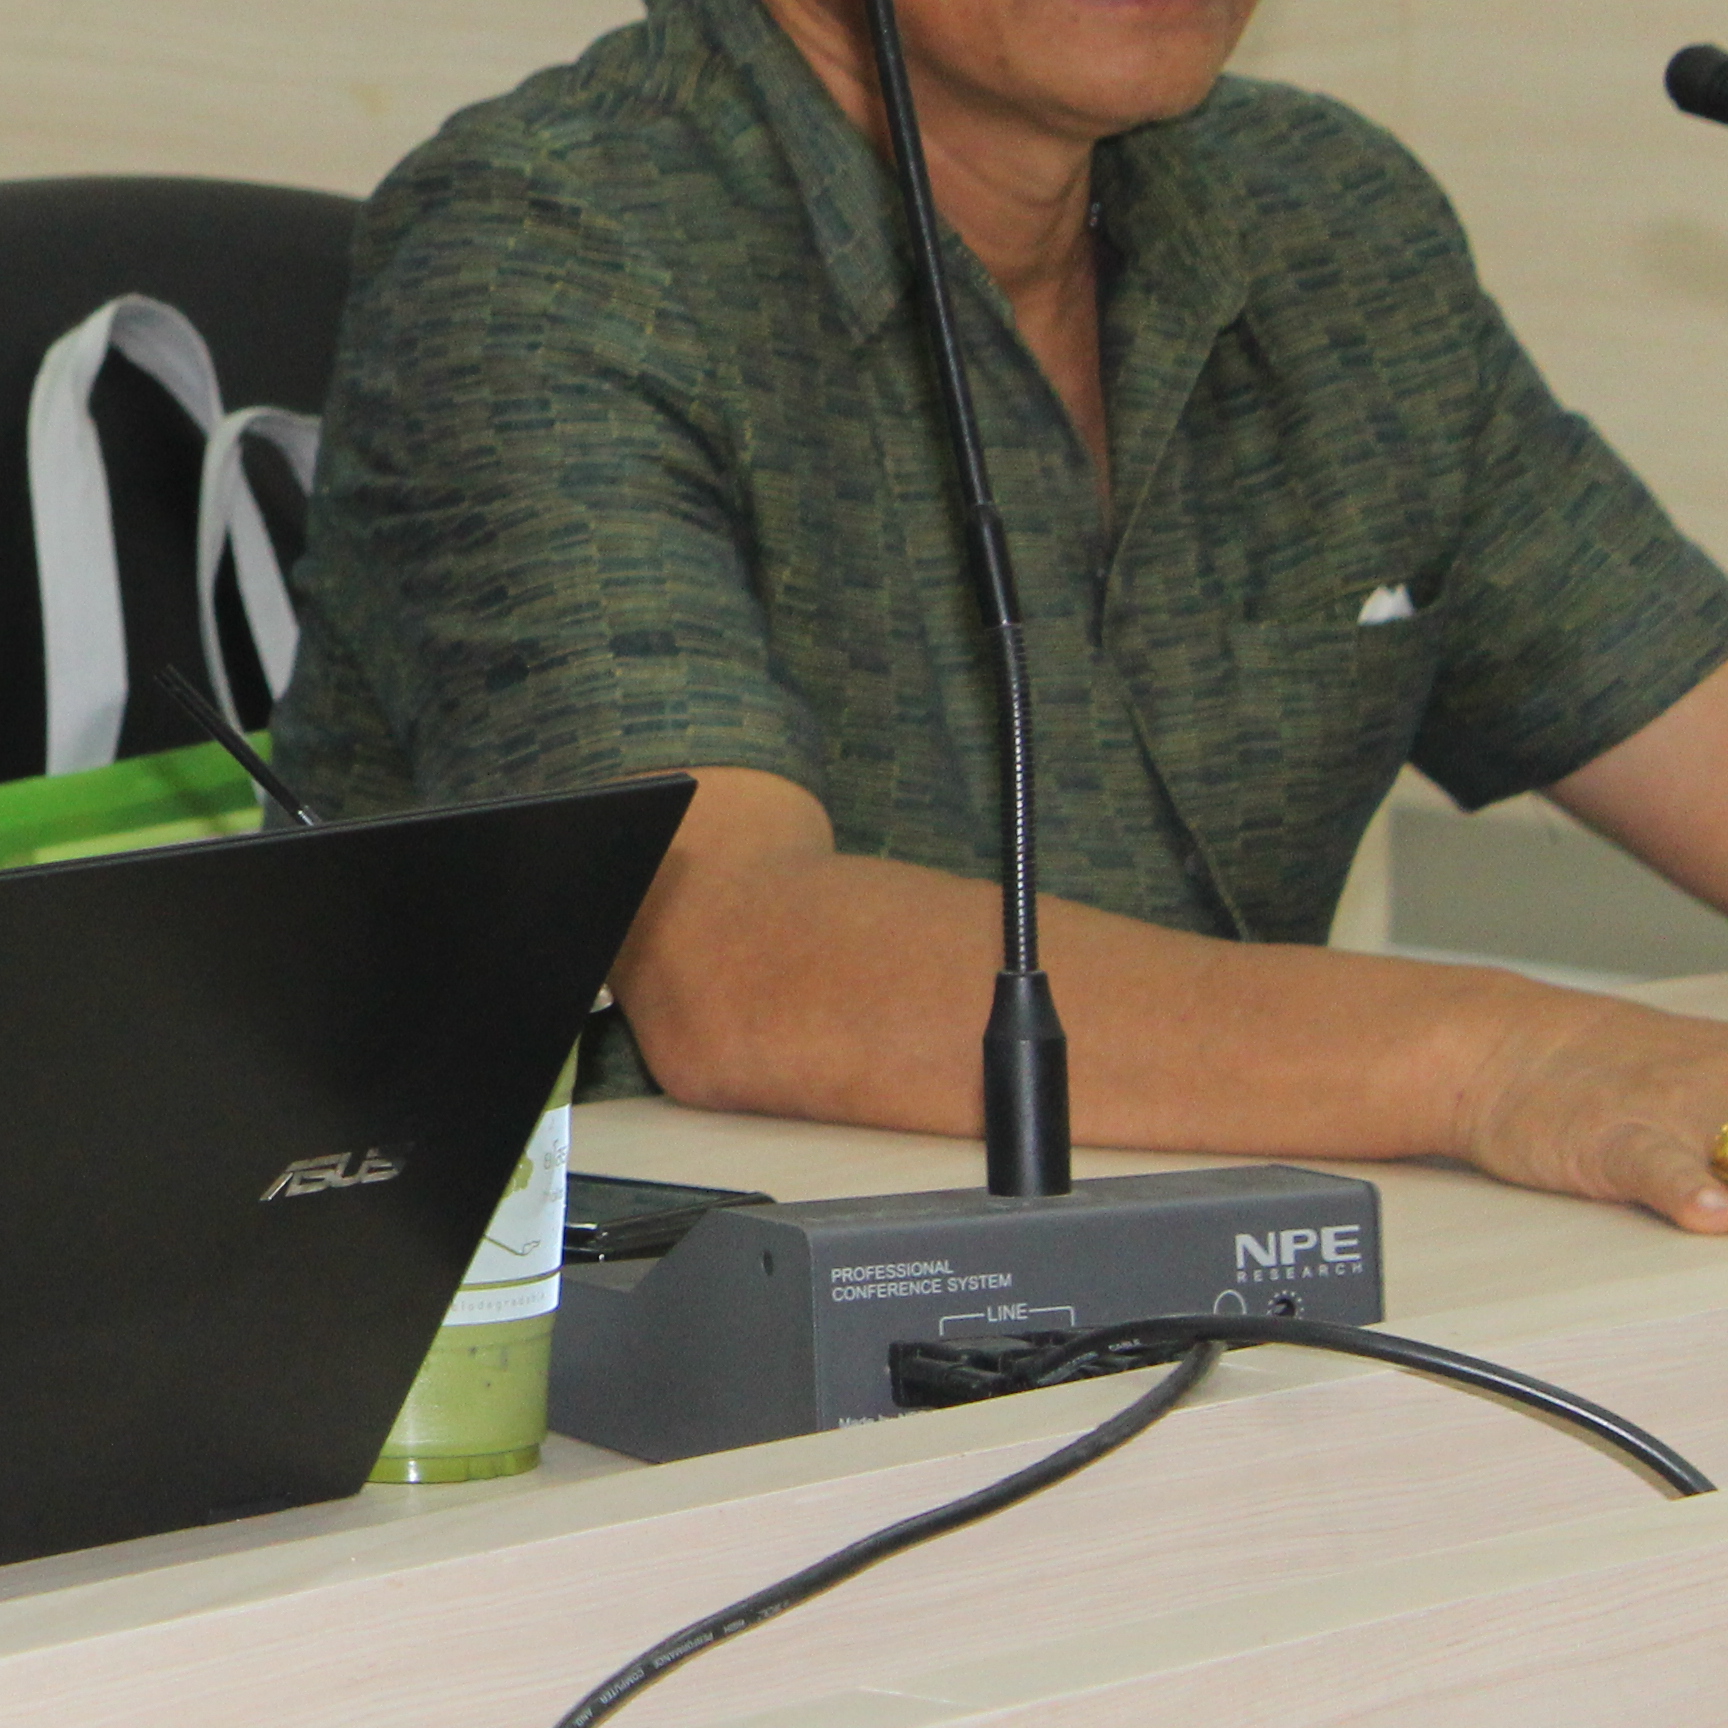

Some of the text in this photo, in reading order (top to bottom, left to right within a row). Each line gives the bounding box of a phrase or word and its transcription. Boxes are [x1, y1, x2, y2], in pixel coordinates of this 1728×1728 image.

[258, 1141, 414, 1202] ASUS
[1235, 1224, 1362, 1270] NPE
[830, 1260, 954, 1284] PROFESSIONAL
[1236, 1262, 1364, 1283] RESEARCH
[831, 1273, 1013, 1302] CONFERENCE SYSTEM
[986, 1303, 1029, 1322] LINE
